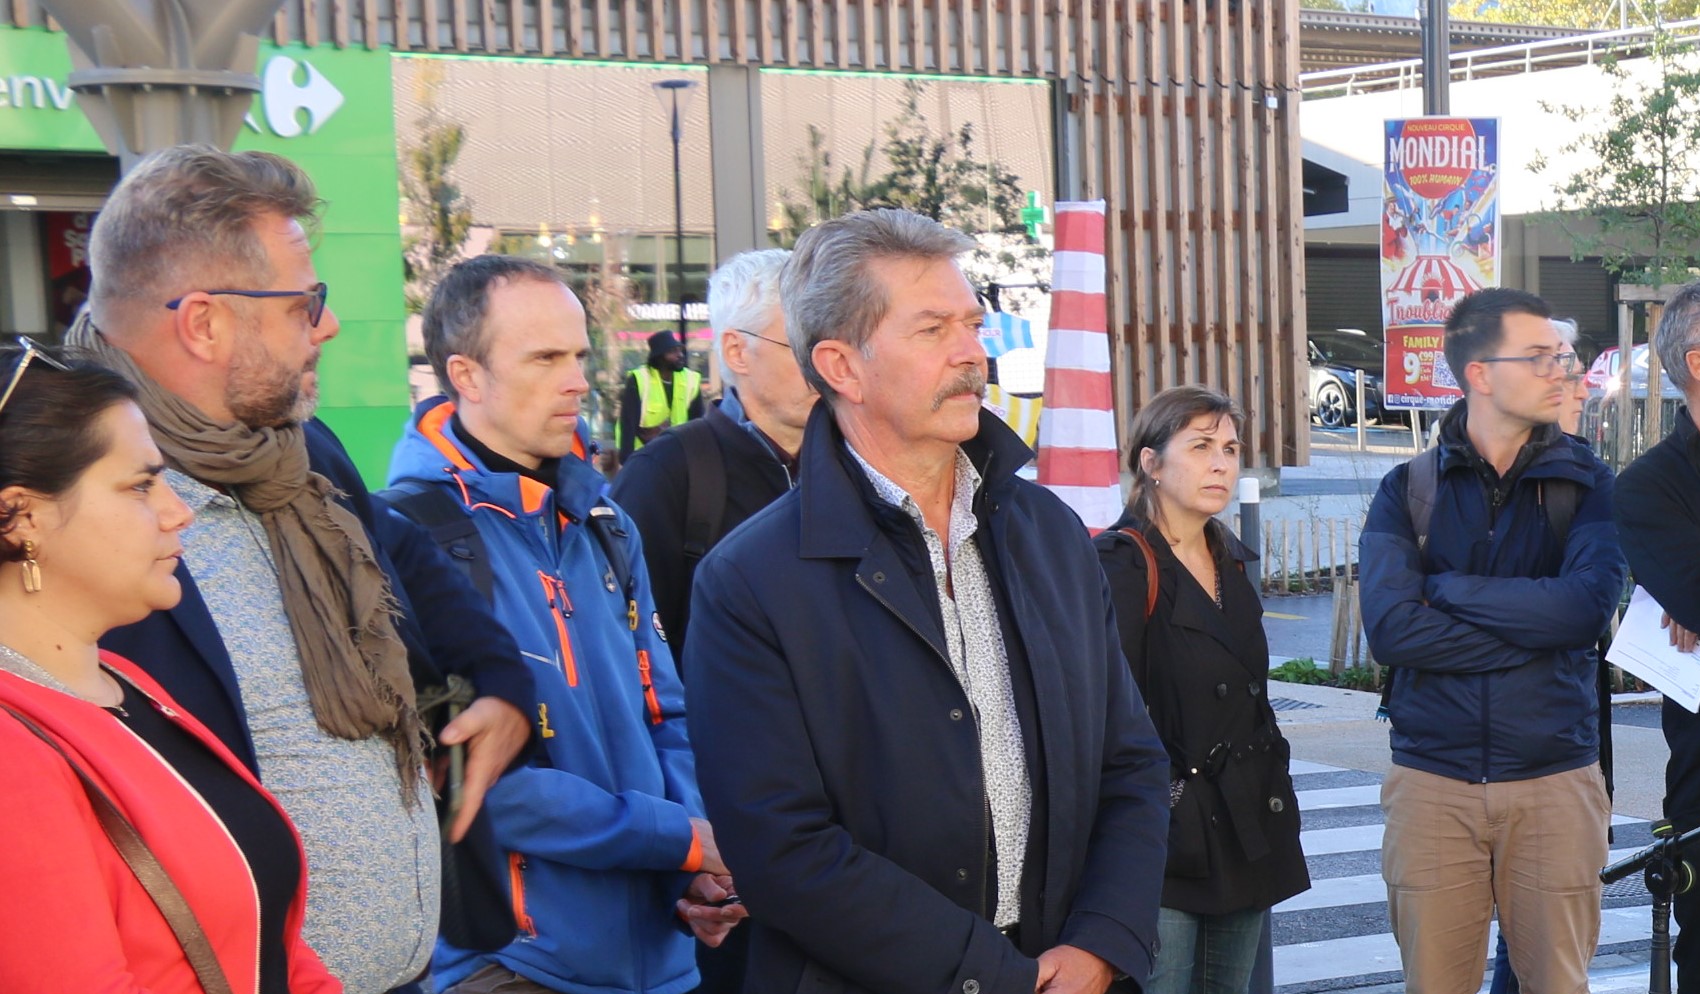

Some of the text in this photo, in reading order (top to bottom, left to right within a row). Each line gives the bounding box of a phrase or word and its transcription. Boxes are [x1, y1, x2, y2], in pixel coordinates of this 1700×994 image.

[1407, 123, 1466, 132] NOUVEAU CIRQUE
[1389, 136, 1489, 173] MONDIAL
[1409, 173, 1463, 186] 100% HUMAIN
[1403, 335, 1440, 348] FAMILY
